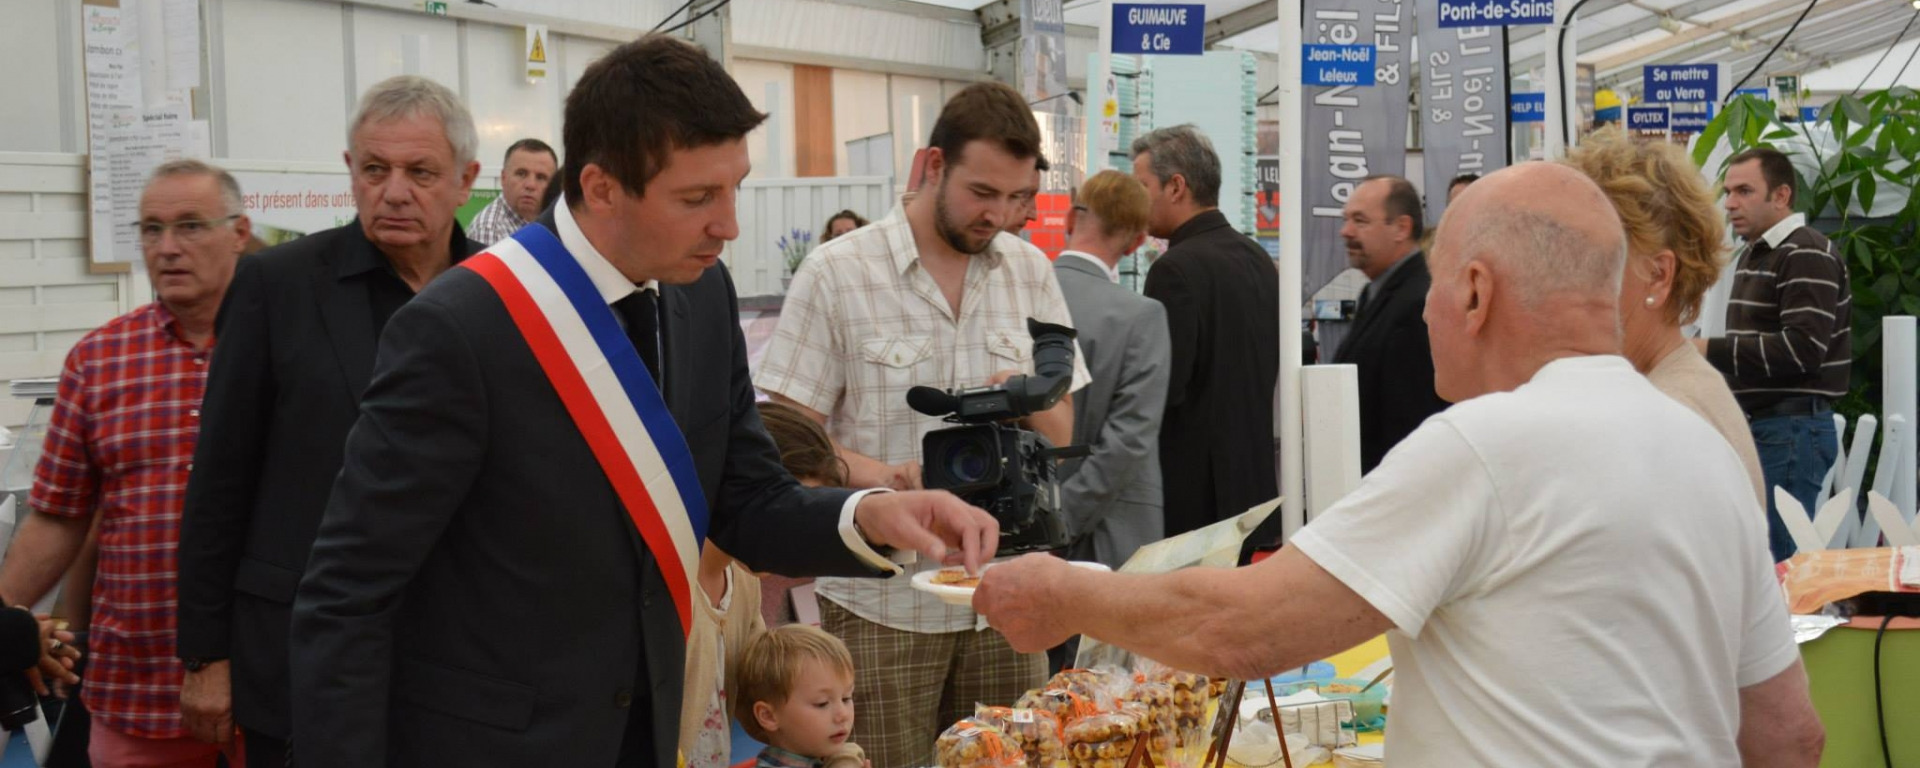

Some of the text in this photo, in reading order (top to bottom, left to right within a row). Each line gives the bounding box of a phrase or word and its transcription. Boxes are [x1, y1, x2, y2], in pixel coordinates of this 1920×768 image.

[1128, 7, 1187, 25] GUIMAUVE
[1440, 0, 1554, 22] Pont-de-Sains
[1141, 33, 1171, 51] & Cie
[1374, 0, 1402, 85] & FIL
[1307, 47, 1371, 62] Jean-Noël
[1319, 67, 1358, 83] Leleux
[1653, 67, 1709, 82] Se mettre
[1656, 86, 1706, 100] au Verre
[1632, 112, 1664, 124] GYLTEX
[243, 191, 260, 209] est
[262, 189, 303, 213] présent
[305, 189, 329, 208] dans
